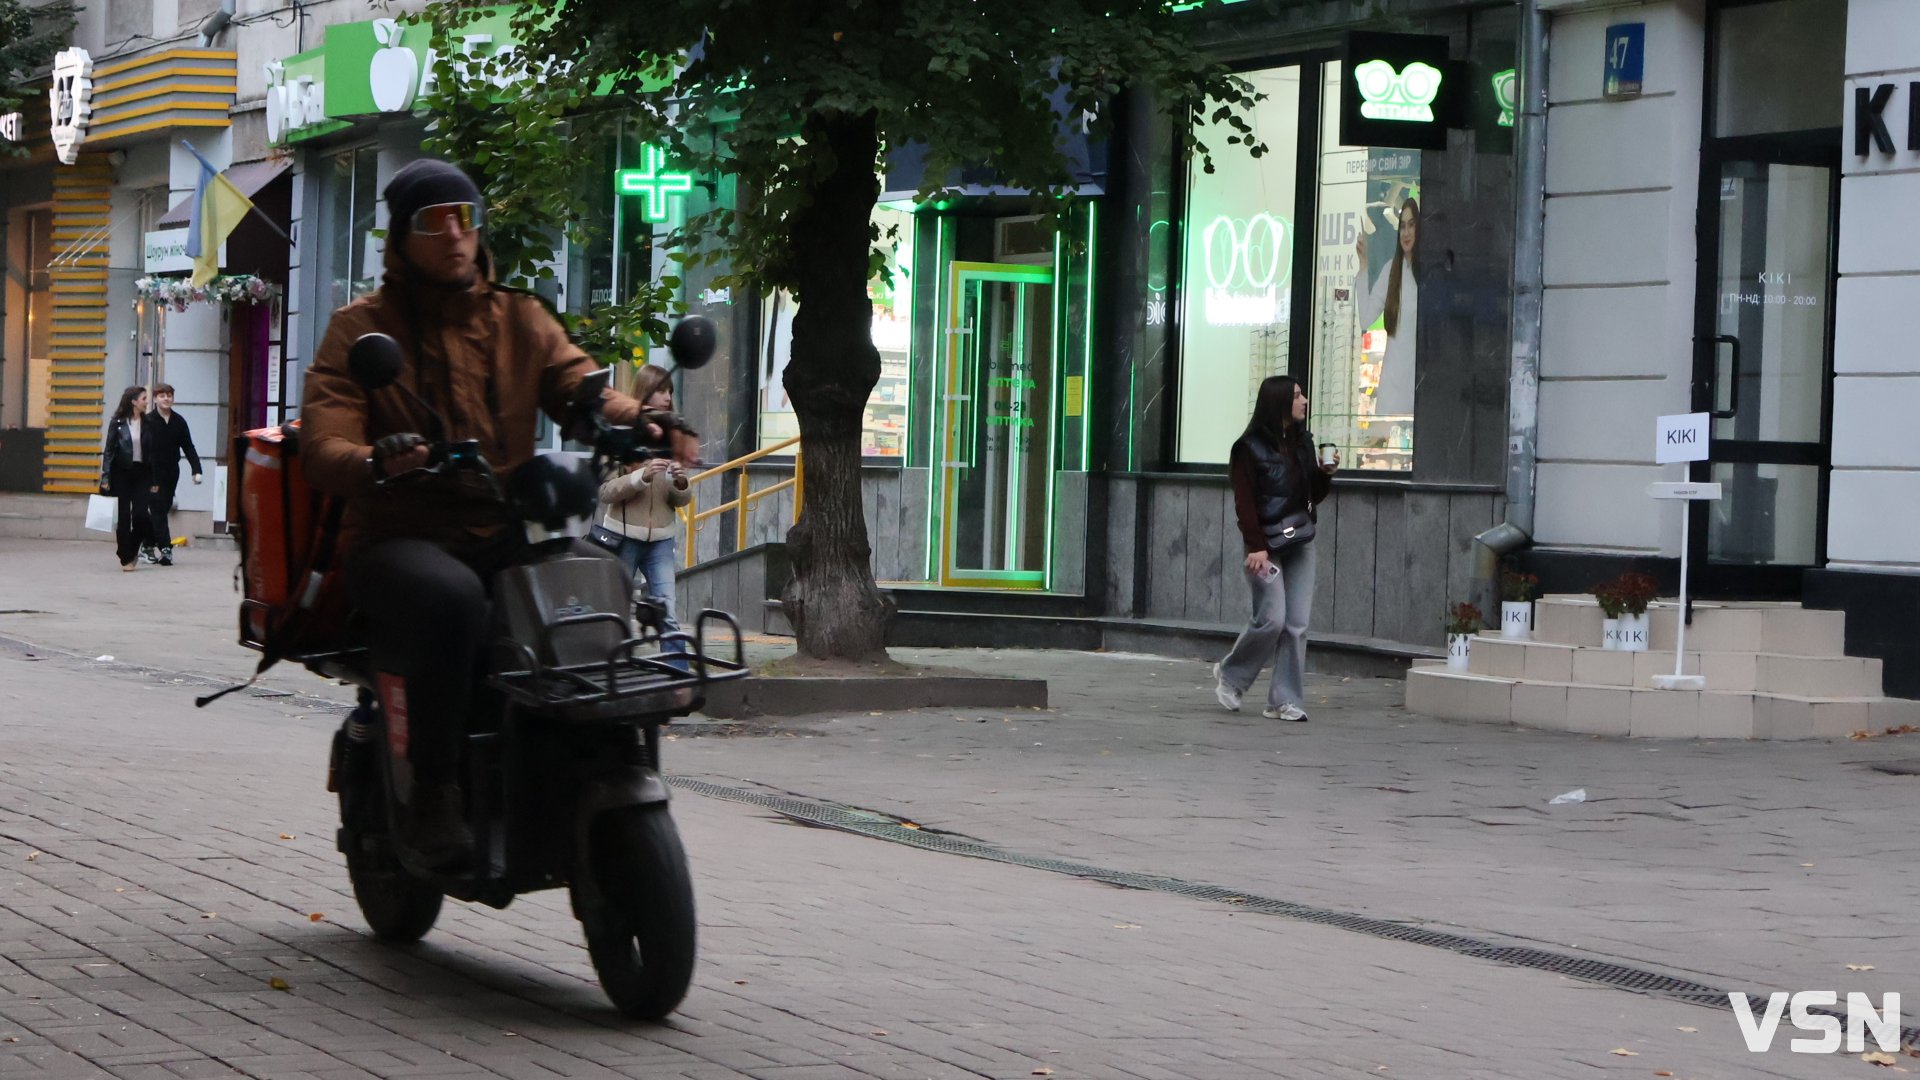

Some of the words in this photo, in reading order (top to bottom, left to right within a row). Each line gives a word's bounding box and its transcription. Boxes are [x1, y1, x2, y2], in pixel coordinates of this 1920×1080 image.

[1610, 37, 1629, 69] 47
[1361, 102, 1433, 120] ОПТИКА
[1346, 159, 1377, 174] ПЕРЕВІР
[1379, 154, 1397, 171] СВІЙ
[1398, 155, 1411, 170] ЗІР
[1758, 272, 1791, 284] KIKI
[1729, 293, 1760, 305] ПН-НД:
[1763, 294, 1786, 304] 10:00
[1793, 296, 1816, 305] 20:00
[986, 415, 1035, 427] ОПТИКА
[1667, 428, 1696, 445] KIKI
[1503, 610, 1528, 623] IKI
